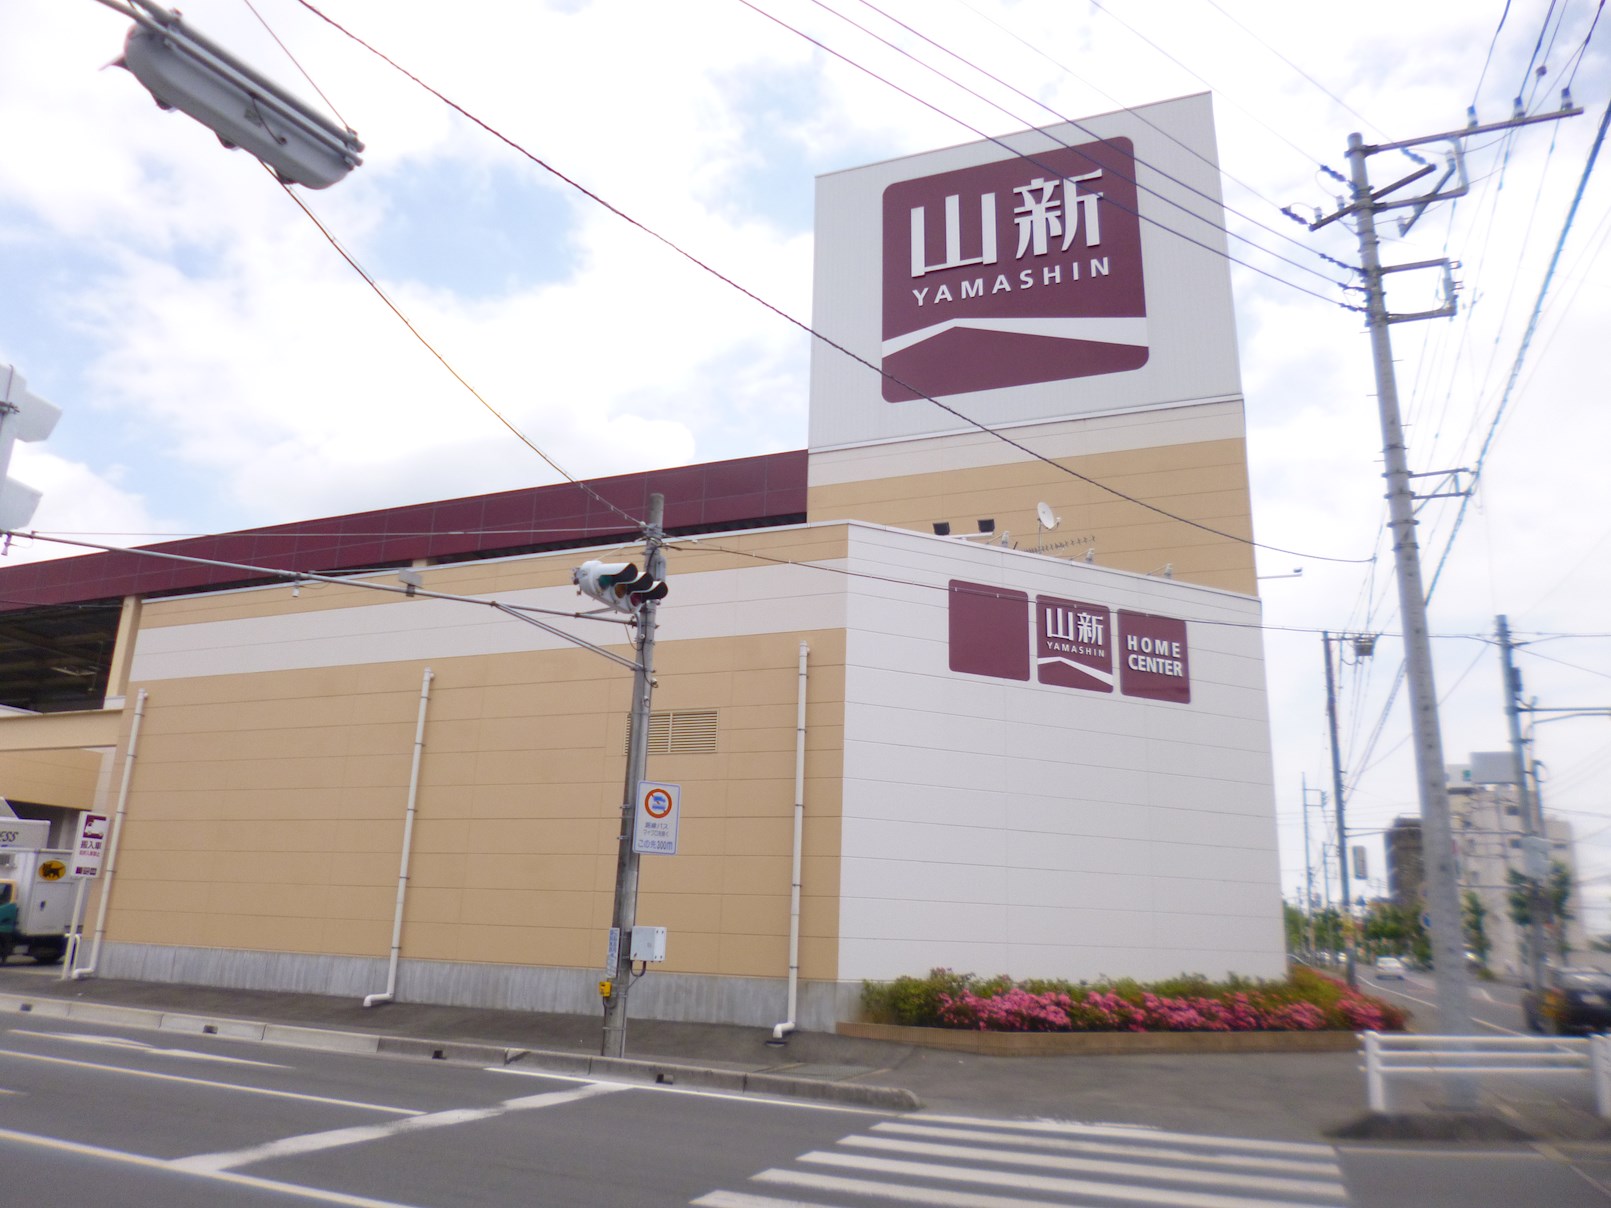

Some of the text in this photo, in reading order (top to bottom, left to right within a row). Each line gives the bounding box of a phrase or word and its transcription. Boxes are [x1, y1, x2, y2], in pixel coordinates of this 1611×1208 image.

[911, 168, 1104, 278] 山新
[912, 257, 1110, 306] YAMASHIN
[1046, 607, 1104, 646] 山新
[1046, 641, 1105, 658] YAMASHIN
[1127, 634, 1181, 658] HOME
[1128, 654, 1183, 677] CENTER
